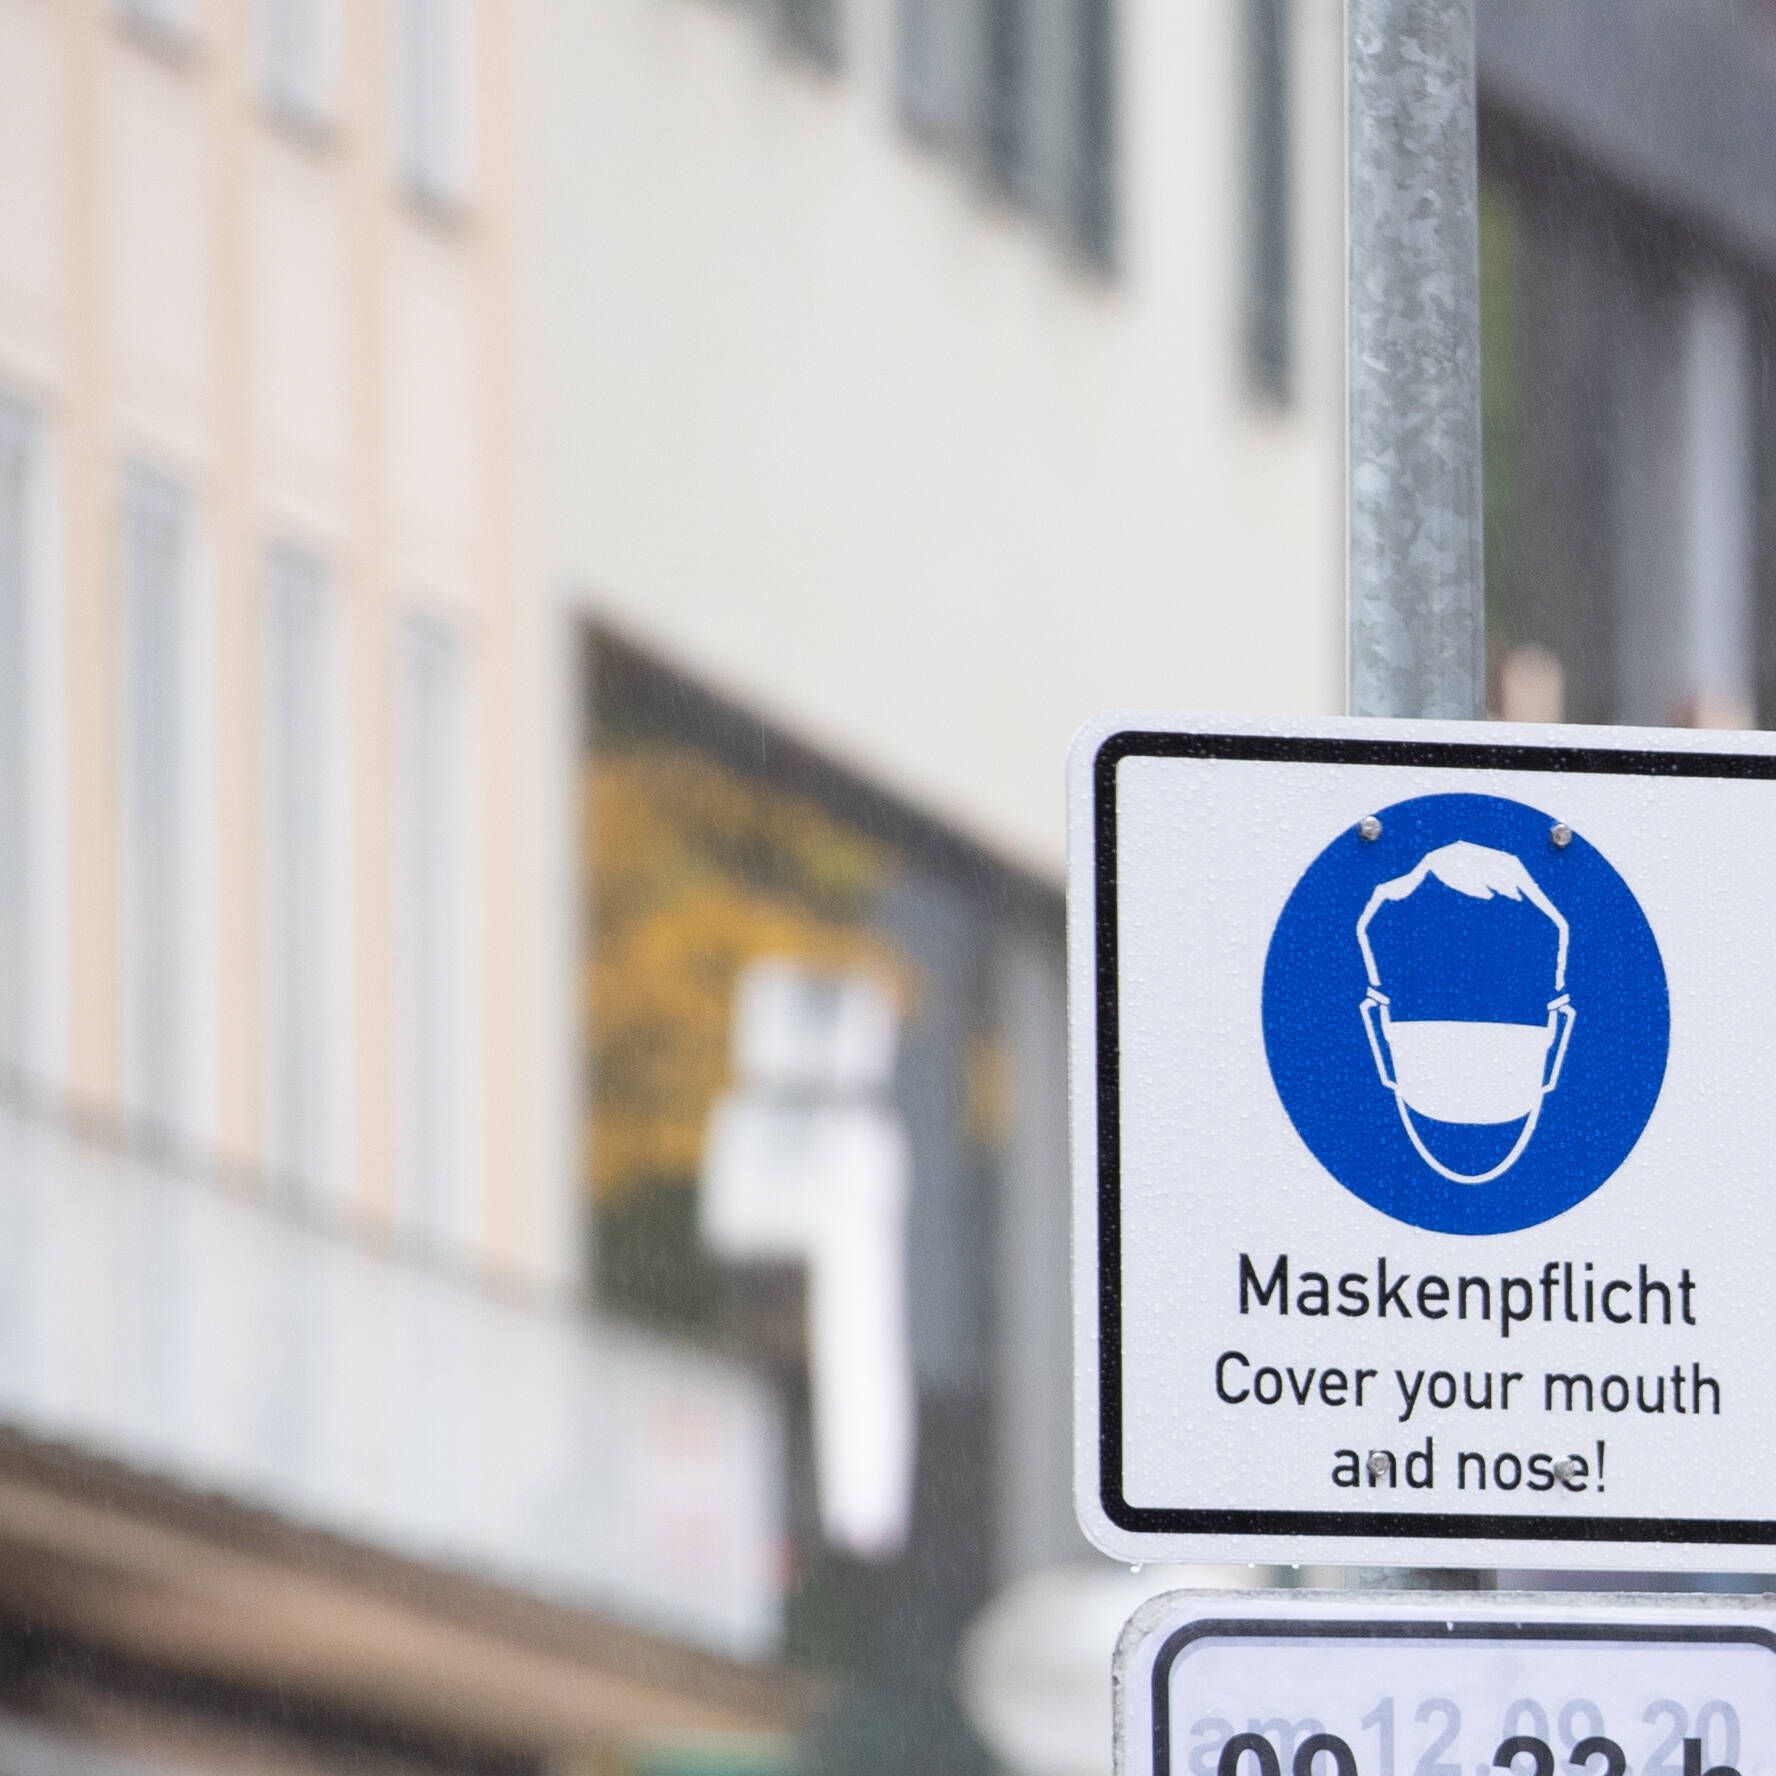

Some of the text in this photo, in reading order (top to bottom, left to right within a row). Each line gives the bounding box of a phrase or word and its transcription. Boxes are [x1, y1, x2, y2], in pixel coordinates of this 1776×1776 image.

[1240, 1254, 1696, 1337] Maskenpflicht
[1216, 1351, 1720, 1423] Cover your mouth
[1332, 1437, 1606, 1493] and nose!
